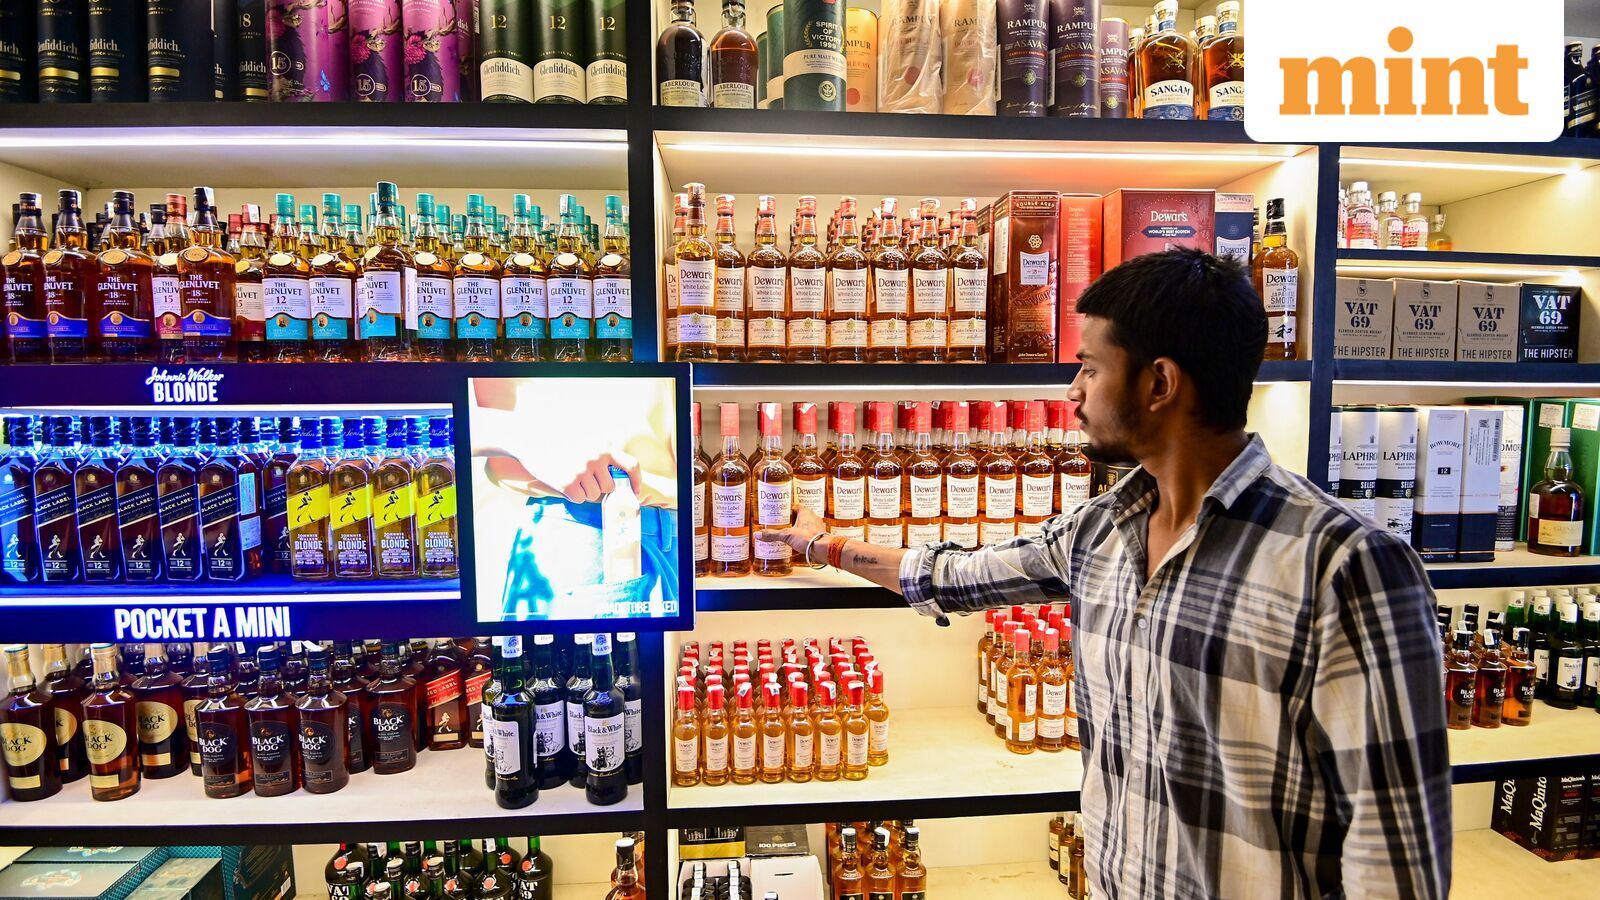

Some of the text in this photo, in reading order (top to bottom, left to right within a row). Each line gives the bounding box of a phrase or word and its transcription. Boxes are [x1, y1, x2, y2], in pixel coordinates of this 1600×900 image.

[491, 15, 507, 29] 12
[549, 16, 566, 30] 12
[599, 16, 616, 31] 12
[1007, 18, 1048, 30] RAMPUR
[1056, 22, 1098, 33] RAMPUR
[820, 41, 836, 49] 1999
[846, 40, 871, 49] MPUR
[1014, 40, 1042, 50] ASAVA
[718, 82, 750, 90] ABERLOUR
[1150, 84, 1190, 97] SANGAM
[1151, 211, 1188, 222] Dewar's
[1220, 245, 1246, 254] Dewar's
[681, 269, 713, 280] Dewar's
[179, 281, 220, 290] GLENLIVET
[754, 276, 784, 286] Dewar's
[793, 277, 823, 286] Dewar's
[835, 277, 865, 287] Dewar's
[879, 277, 906, 287] Dewar's
[916, 277, 945, 288] Dewar's
[958, 277, 986, 287] Dewar's
[98, 283, 138, 292] GLENLIVET
[264, 288, 302, 296] GLENLIVET
[551, 288, 586, 296] GLENLIVET
[596, 288, 630, 296] GLENLIVET
[192, 289, 201, 297] 18
[164, 295, 173, 303] 15
[276, 296, 287, 304] 12
[316, 296, 325, 304] 12
[422, 296, 433, 304] 12
[468, 296, 479, 304] 12
[520, 295, 530, 303] 12
[563, 296, 572, 304] 12
[607, 296, 616, 304] 12
[1533, 295, 1570, 310] VAT
[1345, 301, 1378, 315] VAT
[1408, 304, 1441, 318] VAT
[1473, 307, 1504, 320] VAT
[1539, 310, 1563, 324] 69
[1351, 316, 1371, 329] 69
[1414, 318, 1435, 331] 69
[1478, 320, 1498, 333] 69
[1334, 345, 1386, 358] THE HIPSTER
[1397, 347, 1450, 358] THE HIPSTER
[1462, 349, 1512, 360] THE HIPSTER
[1523, 348, 1574, 359] THE HIPSTER
[146, 366, 224, 385] Johnnie Walker
[154, 382, 218, 402] BLONDE
[1429, 440, 1461, 449] BOWMORE
[1343, 452, 1377, 460] LAPHRO
[796, 487, 823, 495] Dewar's
[836, 487, 862, 495] Dewar's
[871, 485, 897, 495] Dewar's
[914, 485, 940, 494] Dewar's
[950, 485, 976, 494] Dewar's
[989, 486, 1014, 495] Dewar's
[714, 493, 742, 501] Dewar's
[760, 490, 790, 500] Dewar's
[159, 497, 195, 513] BLACK LABEL
[202, 497, 237, 513] BLACK LABEL
[294, 541, 323, 550] BLONDE
[338, 541, 366, 550] BLONDE
[381, 539, 409, 549] BLONDE
[425, 538, 453, 548] BLONDE
[114, 606, 291, 640] POCKET A MINI
[536, 711, 562, 720] k&White
[373, 715, 403, 726] BLACK
[378, 723, 398, 732] DOG
[199, 738, 228, 747] BLACK
[252, 736, 284, 745] BLACK
[299, 736, 326, 744] BLACK
[202, 744, 222, 753] DOG
[257, 743, 278, 751] DOG
[302, 742, 320, 751] DOG
[1529, 776, 1547, 831] MaQinto
